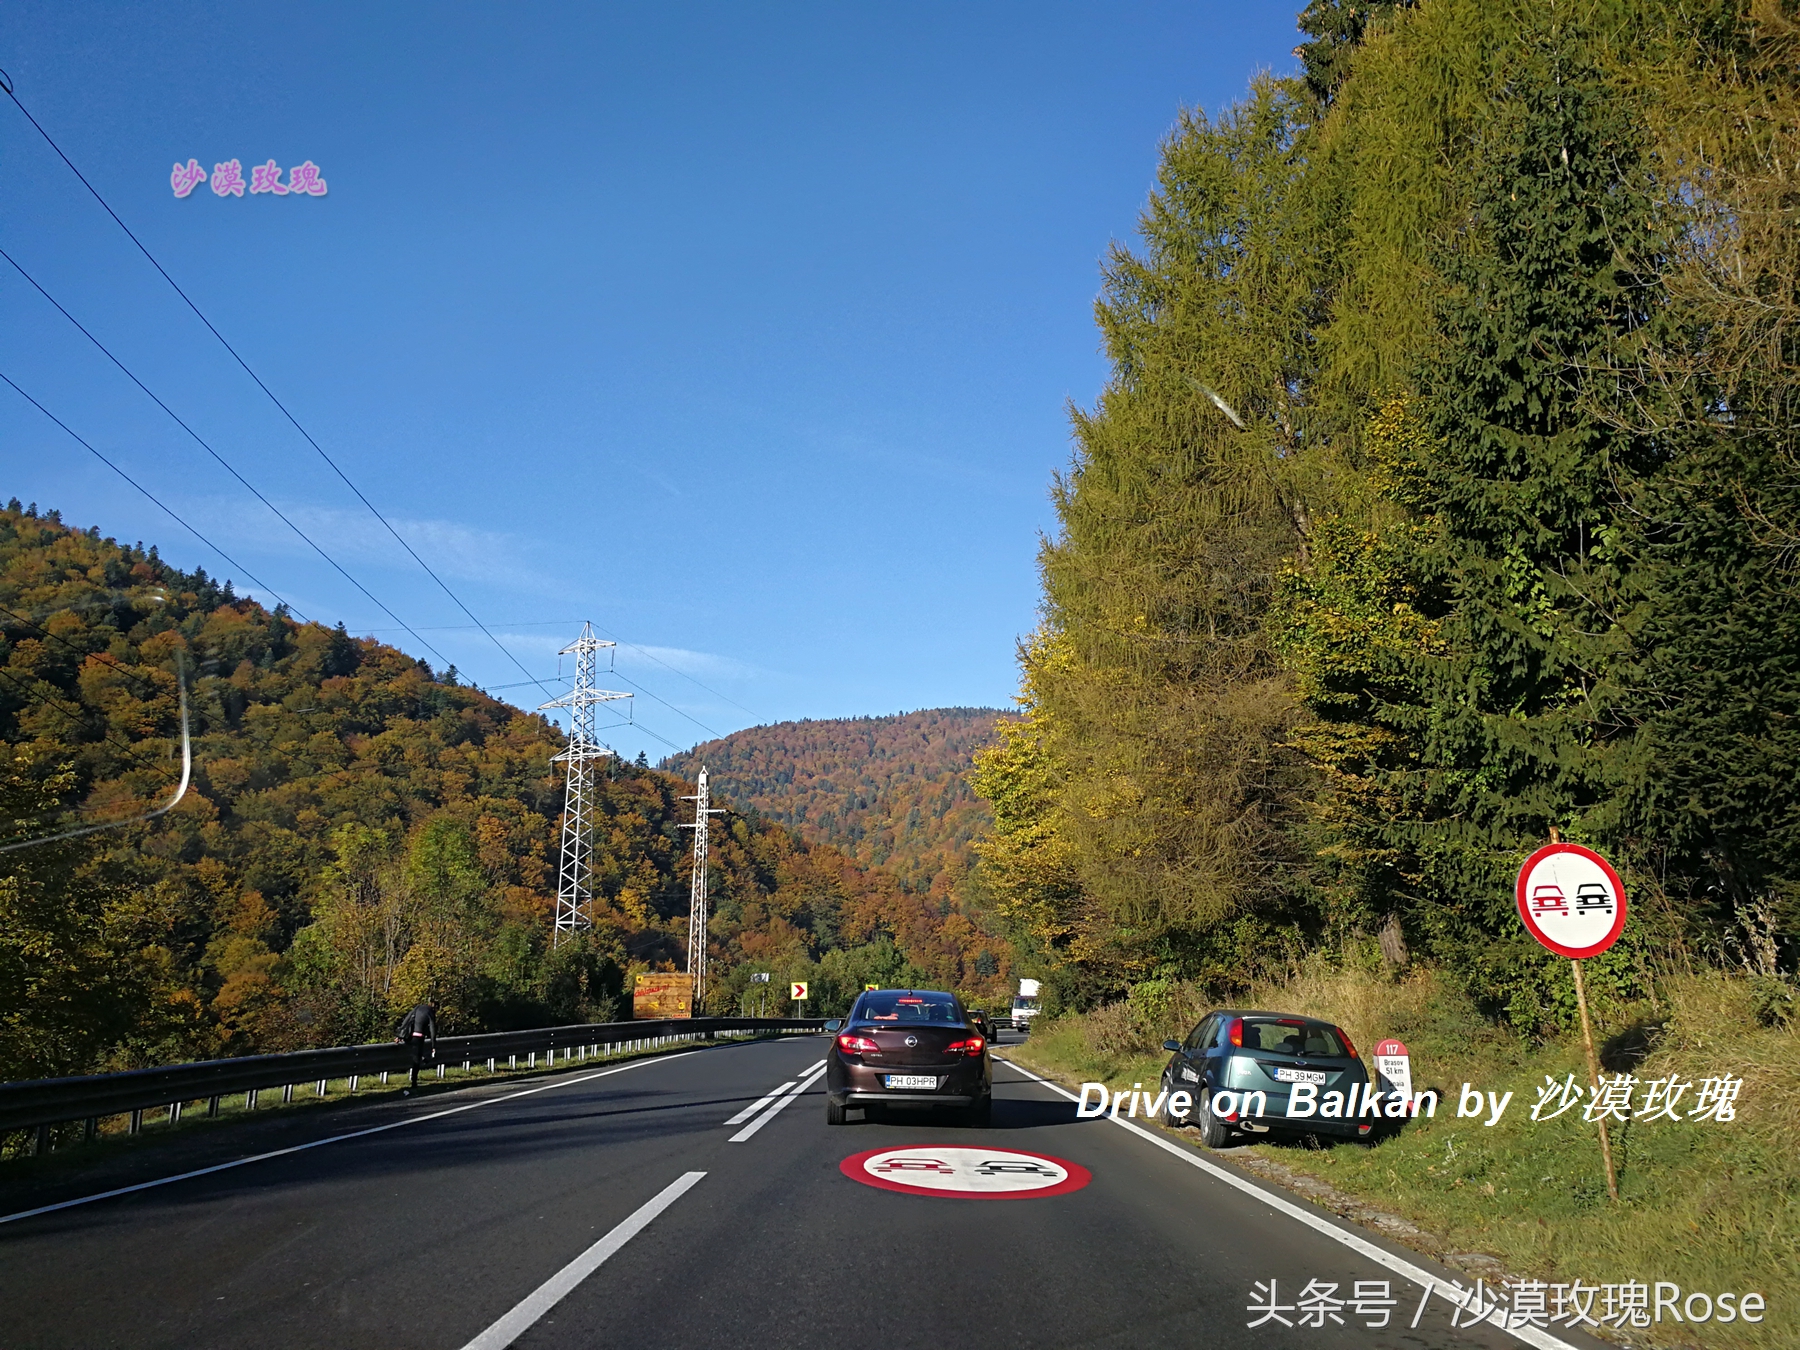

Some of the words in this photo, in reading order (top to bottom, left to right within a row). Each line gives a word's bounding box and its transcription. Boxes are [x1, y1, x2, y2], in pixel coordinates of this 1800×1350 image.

[1386, 1044, 1398, 1055] 117
[1280, 1070, 1291, 1079] PH
[890, 1077, 903, 1085] PH
[906, 1077, 935, 1085] 03HPR
